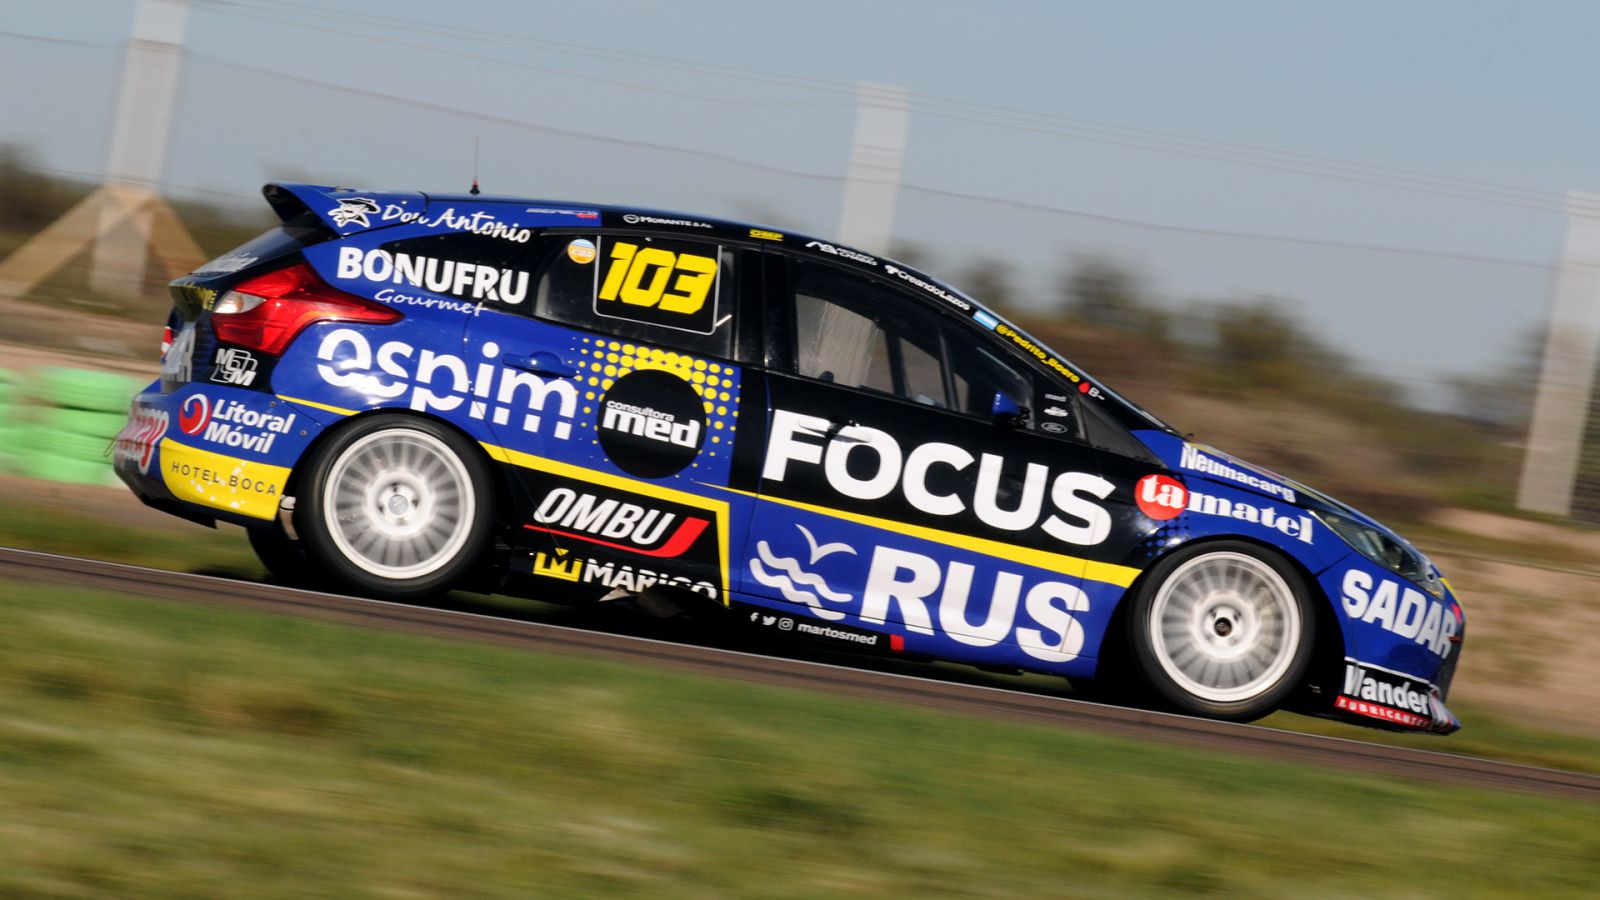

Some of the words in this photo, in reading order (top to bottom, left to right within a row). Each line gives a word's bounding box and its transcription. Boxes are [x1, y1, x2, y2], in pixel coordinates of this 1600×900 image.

[381, 204, 430, 226] Don
[428, 208, 531, 243] Antonio
[337, 247, 530, 304] BONUFRU
[598, 242, 717, 315] 103
[374, 289, 488, 316] Gourmet
[316, 328, 577, 440] espim
[211, 399, 296, 434] Litoral
[602, 407, 701, 448] med
[606, 400, 675, 422] consultora
[203, 421, 276, 453] Móvil
[171, 461, 219, 484] HOTEL
[229, 475, 276, 496] BOCA
[762, 409, 1116, 545] FOCUS
[1179, 442, 1296, 503] Neumacarg
[533, 487, 676, 545] OMBU
[859, 545, 1090, 663] RUS
[1342, 569, 1456, 659] SADAR
[797, 622, 878, 645] martosmed
[1344, 664, 1430, 715] Wander
